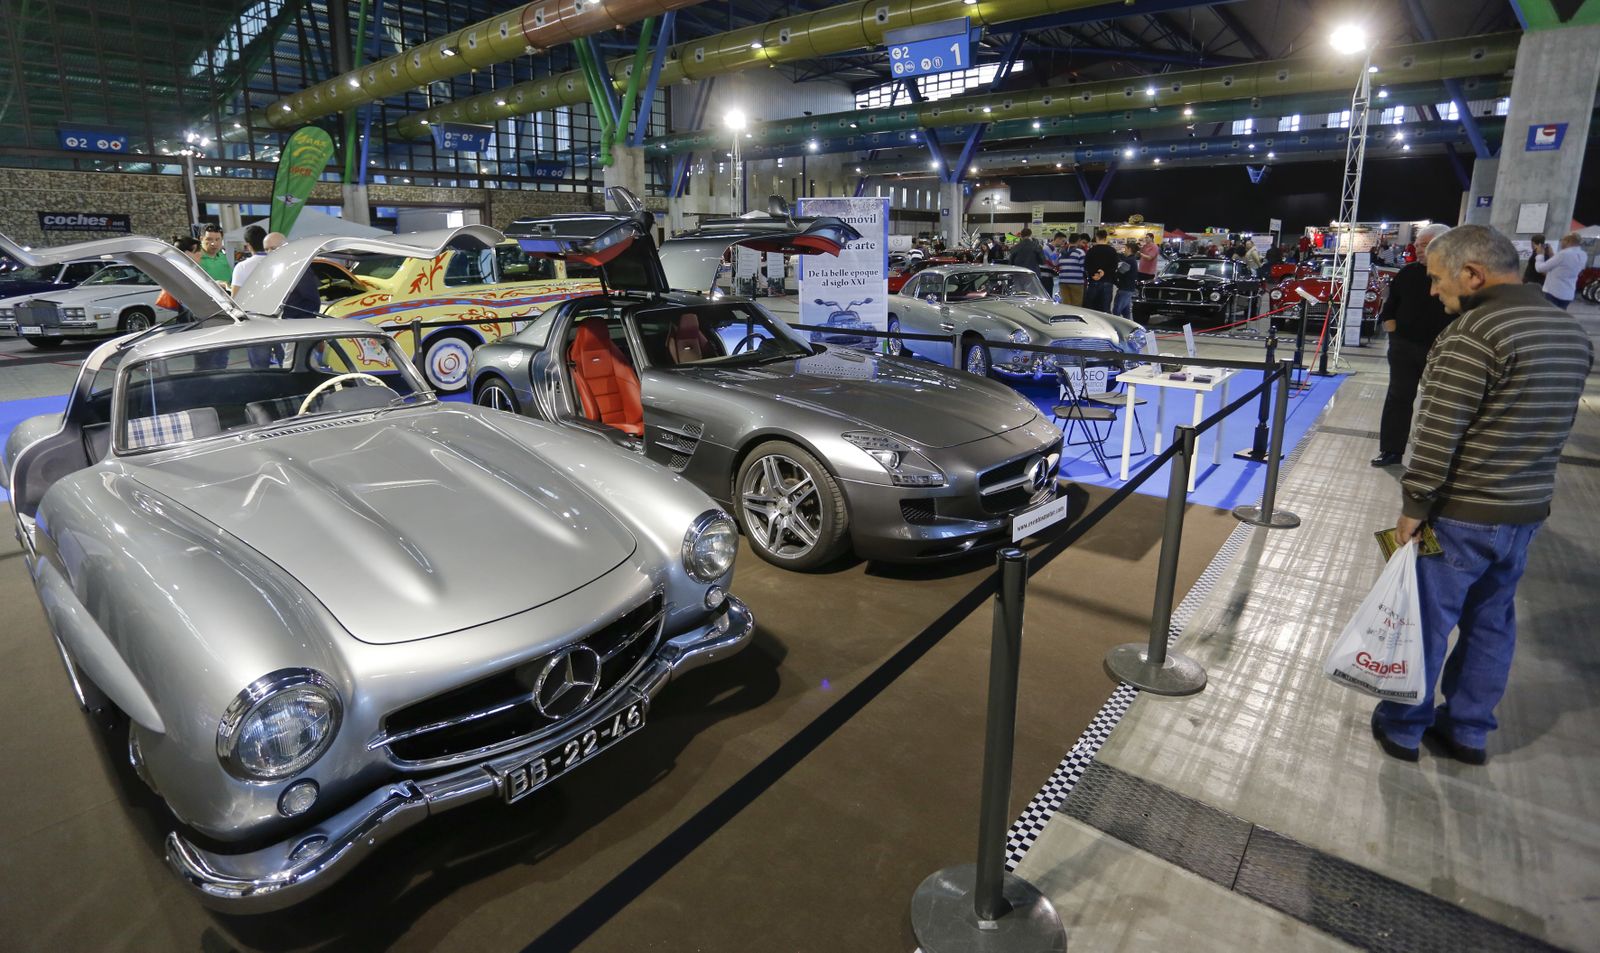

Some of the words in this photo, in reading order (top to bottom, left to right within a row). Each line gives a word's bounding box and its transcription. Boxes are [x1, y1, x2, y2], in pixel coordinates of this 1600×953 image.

[902, 46, 910, 59] 2
[950, 42, 961, 66] 1
[79, 138, 88, 149] 2
[468, 134, 474, 142] 2
[480, 138, 485, 151] 1
[839, 213, 877, 224] omóvil
[855, 241, 876, 250] arte
[808, 270, 820, 278] De
[821, 269, 828, 277] la
[830, 269, 850, 277] belle
[850, 269, 879, 279] epoque
[821, 279, 829, 287] al
[830, 279, 849, 288] siglo
[850, 278, 866, 286] XXI
[1068, 370, 1105, 381] MUSEO
[510, 704, 641, 798] BB-22-46
